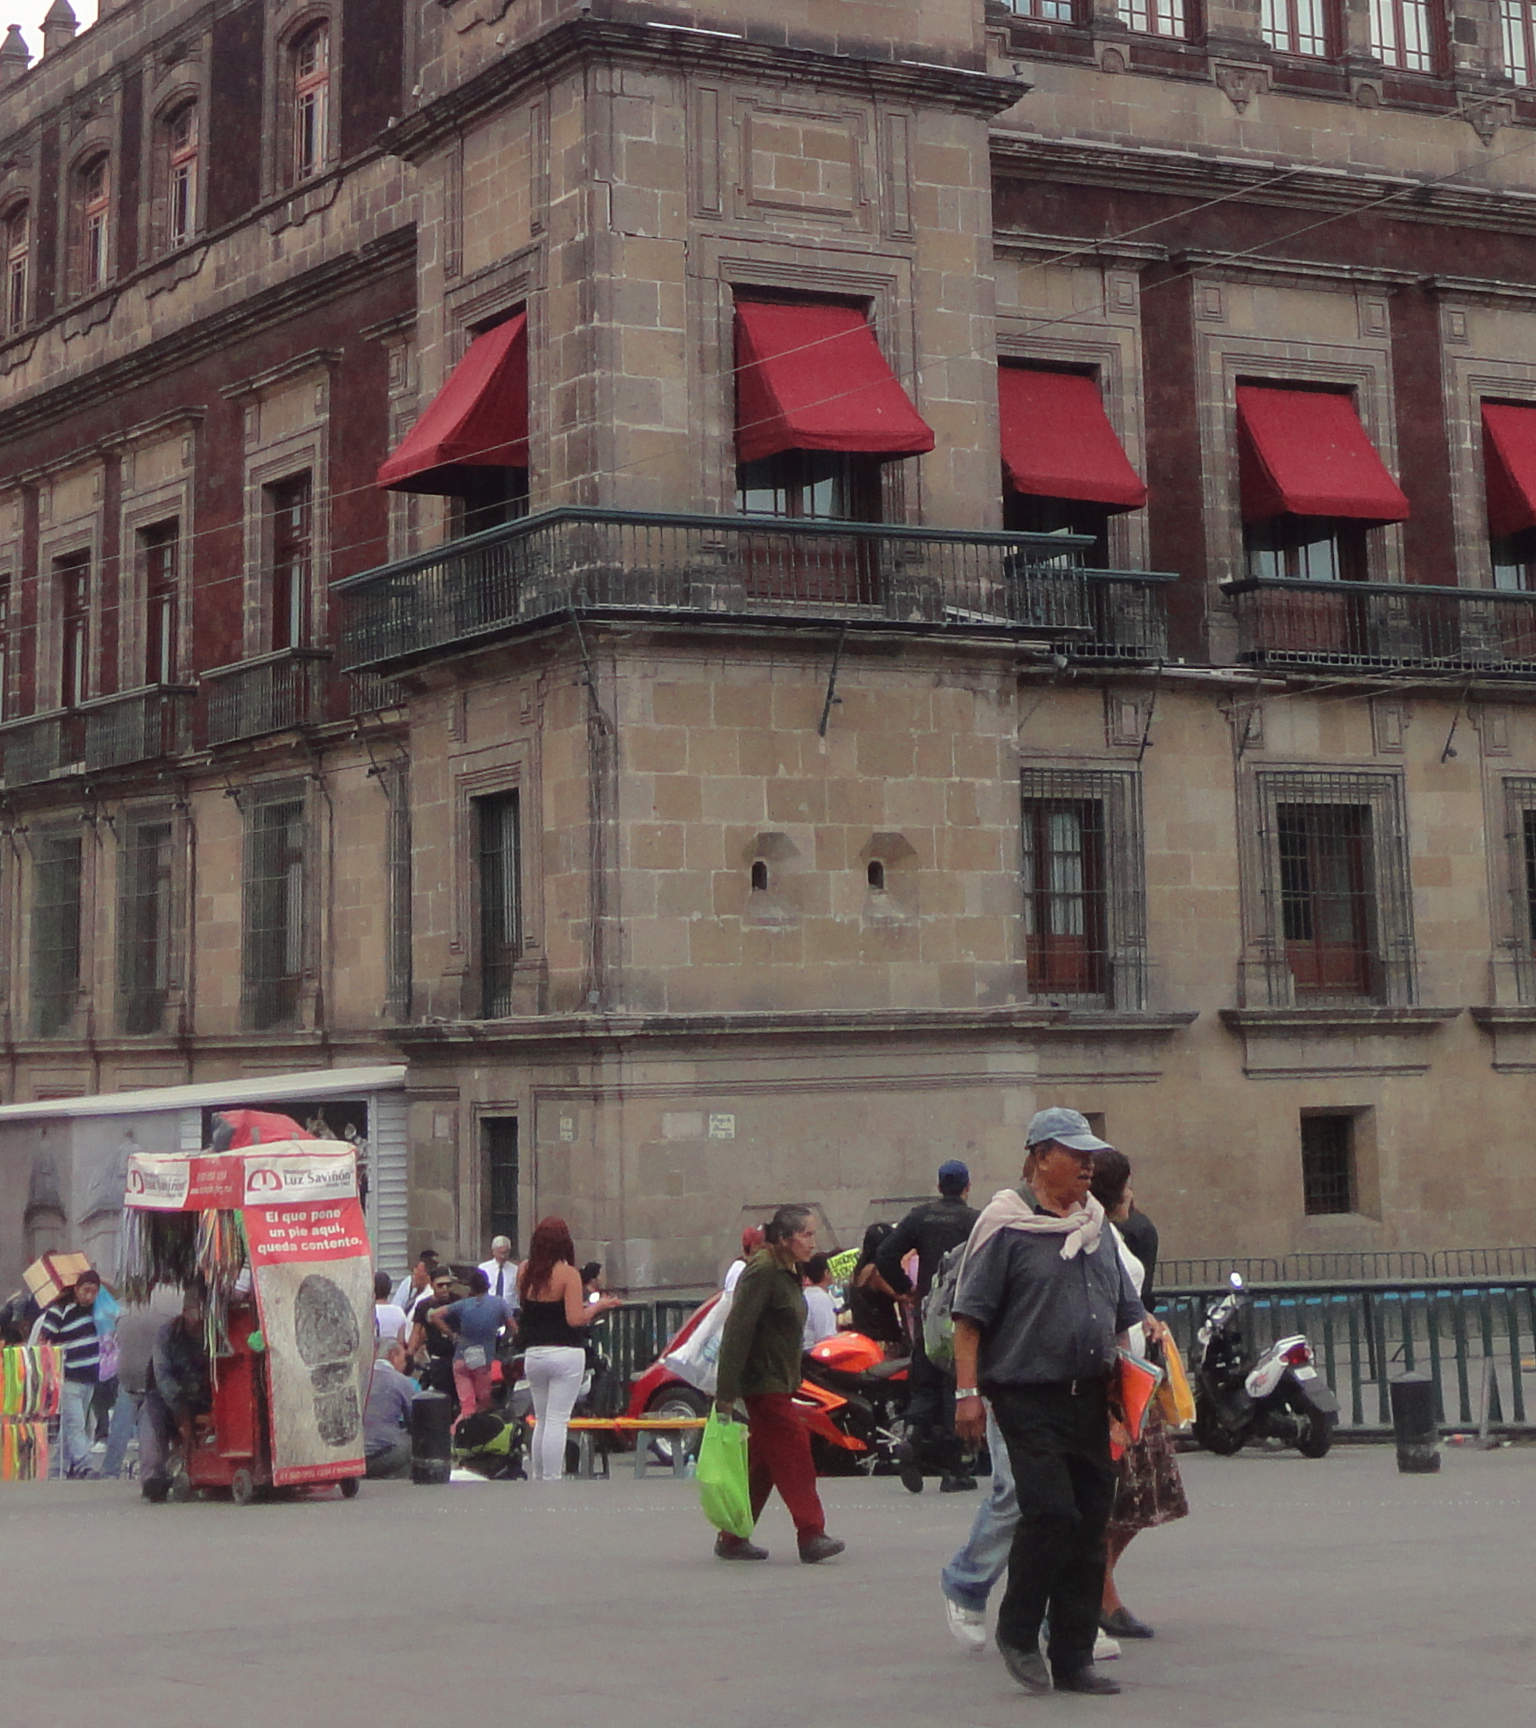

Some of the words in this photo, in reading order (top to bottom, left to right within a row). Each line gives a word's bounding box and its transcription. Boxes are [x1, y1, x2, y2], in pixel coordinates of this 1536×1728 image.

[284, 1174, 304, 1185] Luz
[306, 1168, 351, 1184] Saviñón
[265, 1211, 279, 1223] El
[282, 1211, 307, 1224] que
[311, 1209, 341, 1223] pone
[269, 1229, 285, 1238] un
[288, 1226, 308, 1239] pie
[257, 1241, 298, 1255] queda
[300, 1236, 363, 1251] contento.
